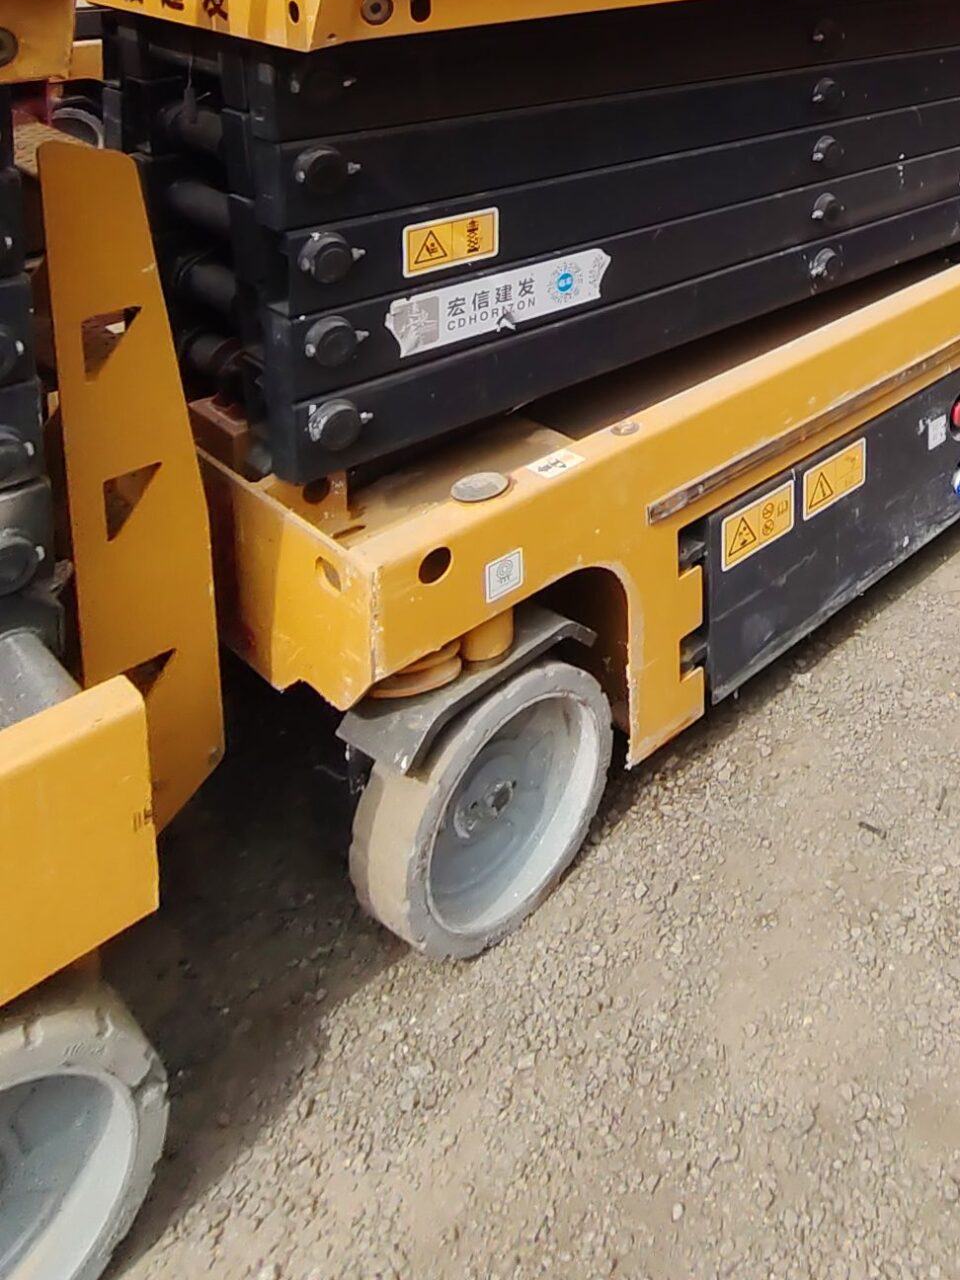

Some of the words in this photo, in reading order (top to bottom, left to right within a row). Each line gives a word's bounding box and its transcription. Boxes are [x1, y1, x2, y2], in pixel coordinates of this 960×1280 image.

[447, 278, 536, 317] 宏信建发
[447, 297, 537, 331] CDHORIZON
